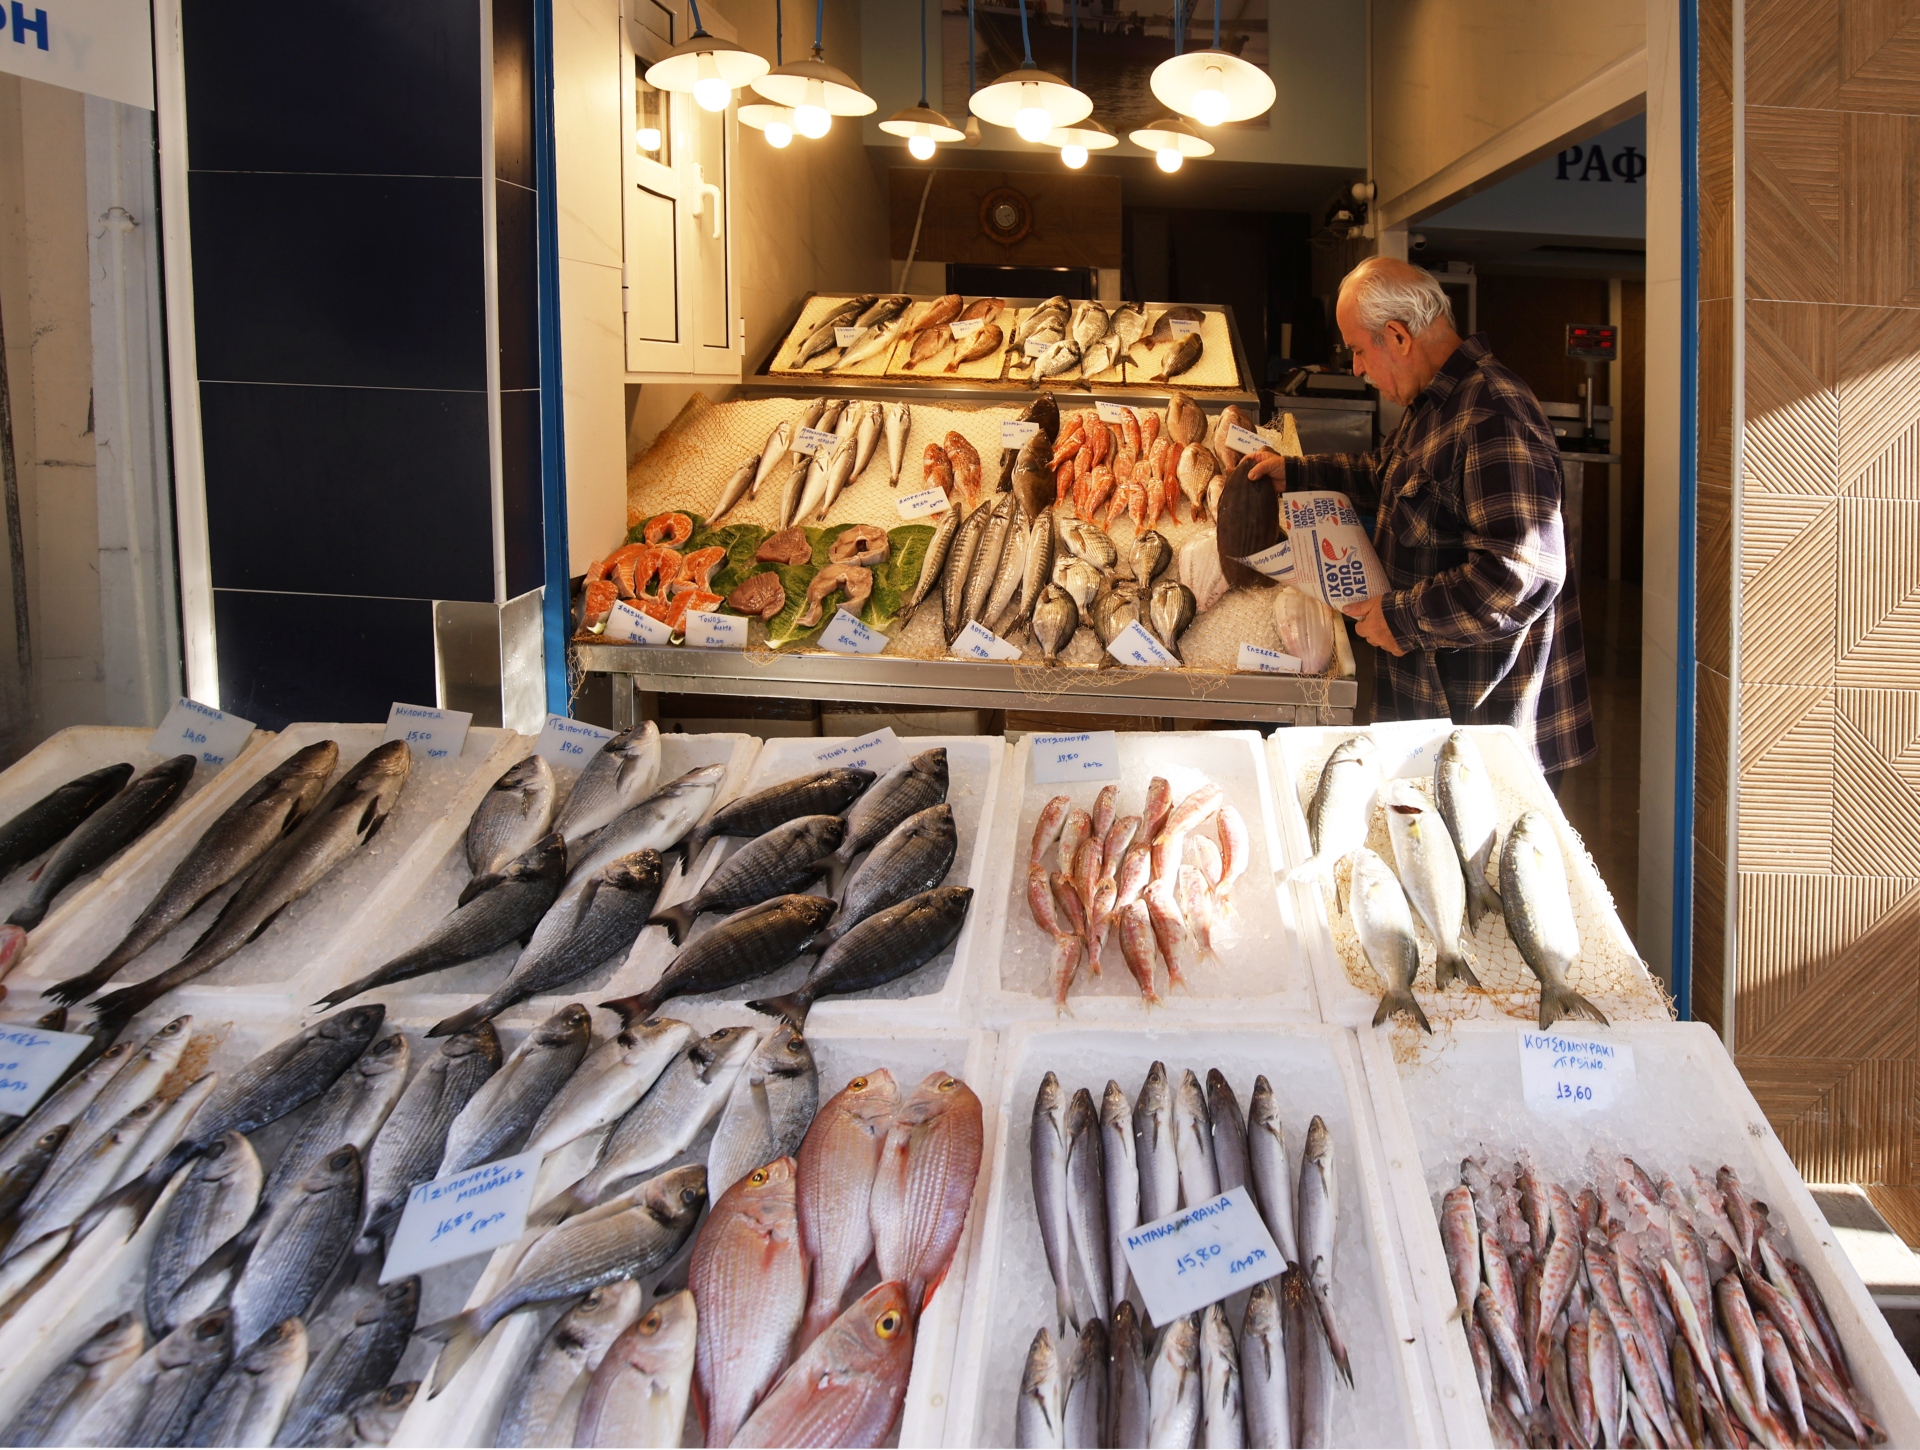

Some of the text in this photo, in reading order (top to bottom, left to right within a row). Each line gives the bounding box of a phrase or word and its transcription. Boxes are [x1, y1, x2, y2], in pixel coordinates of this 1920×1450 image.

[1324, 562, 1341, 597] ΙΧΘΥ
[1339, 564, 1354, 597] ΟΠΩ
[1351, 561, 1367, 595] ΛΕΙΟ
[182, 728, 207, 744] 14,60
[405, 731, 432, 742] 15,60
[548, 717, 610, 739] ΤΣΙΠΟΥΡΕΣ
[560, 740, 584, 755] 19,60
[1556, 1081, 1592, 1102] 13,60
[413, 1165, 507, 1203] ΤΣΙΠΟΥΡΕΣ
[1177, 1244, 1221, 1276] 15,80
